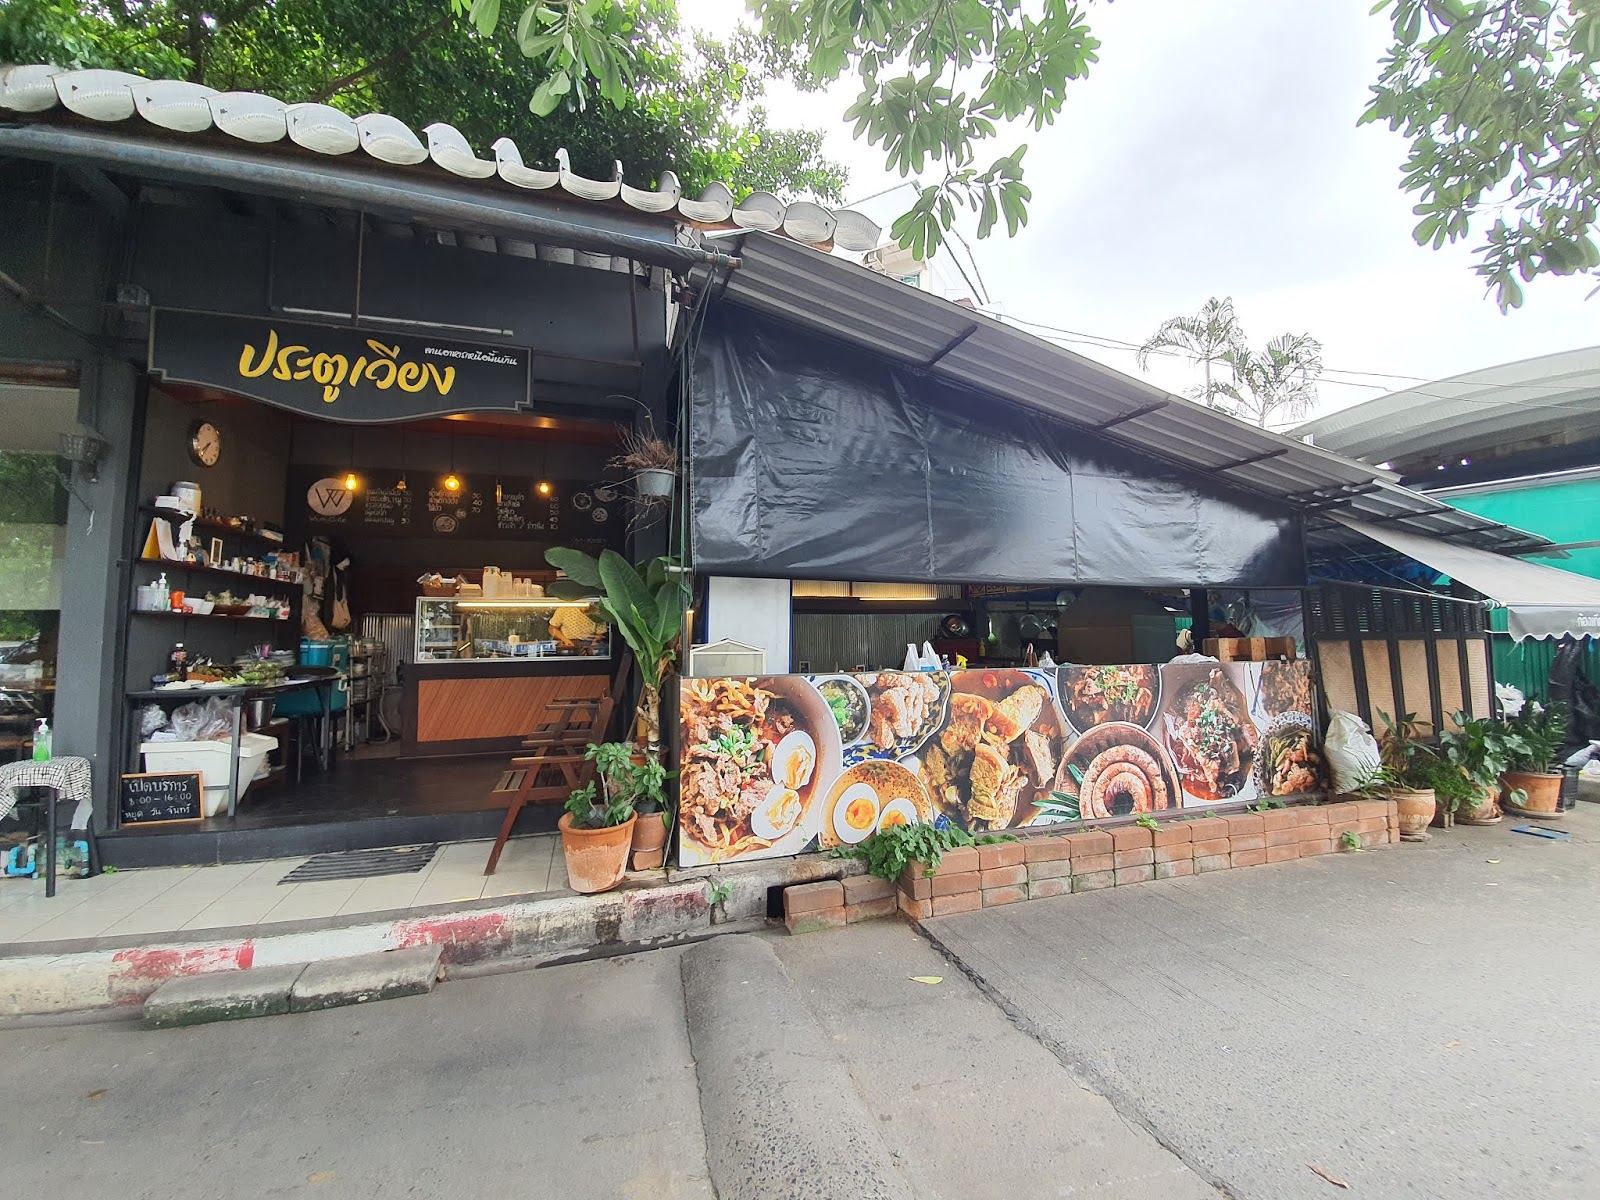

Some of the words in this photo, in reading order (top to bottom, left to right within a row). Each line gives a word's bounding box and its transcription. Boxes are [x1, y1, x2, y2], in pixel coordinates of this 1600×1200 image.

[239, 329, 456, 403] ประตูเวียง
[125, 810, 144, 821] หยุด
[150, 808, 162, 816] วัน
[166, 803, 191, 814] จันทร์
